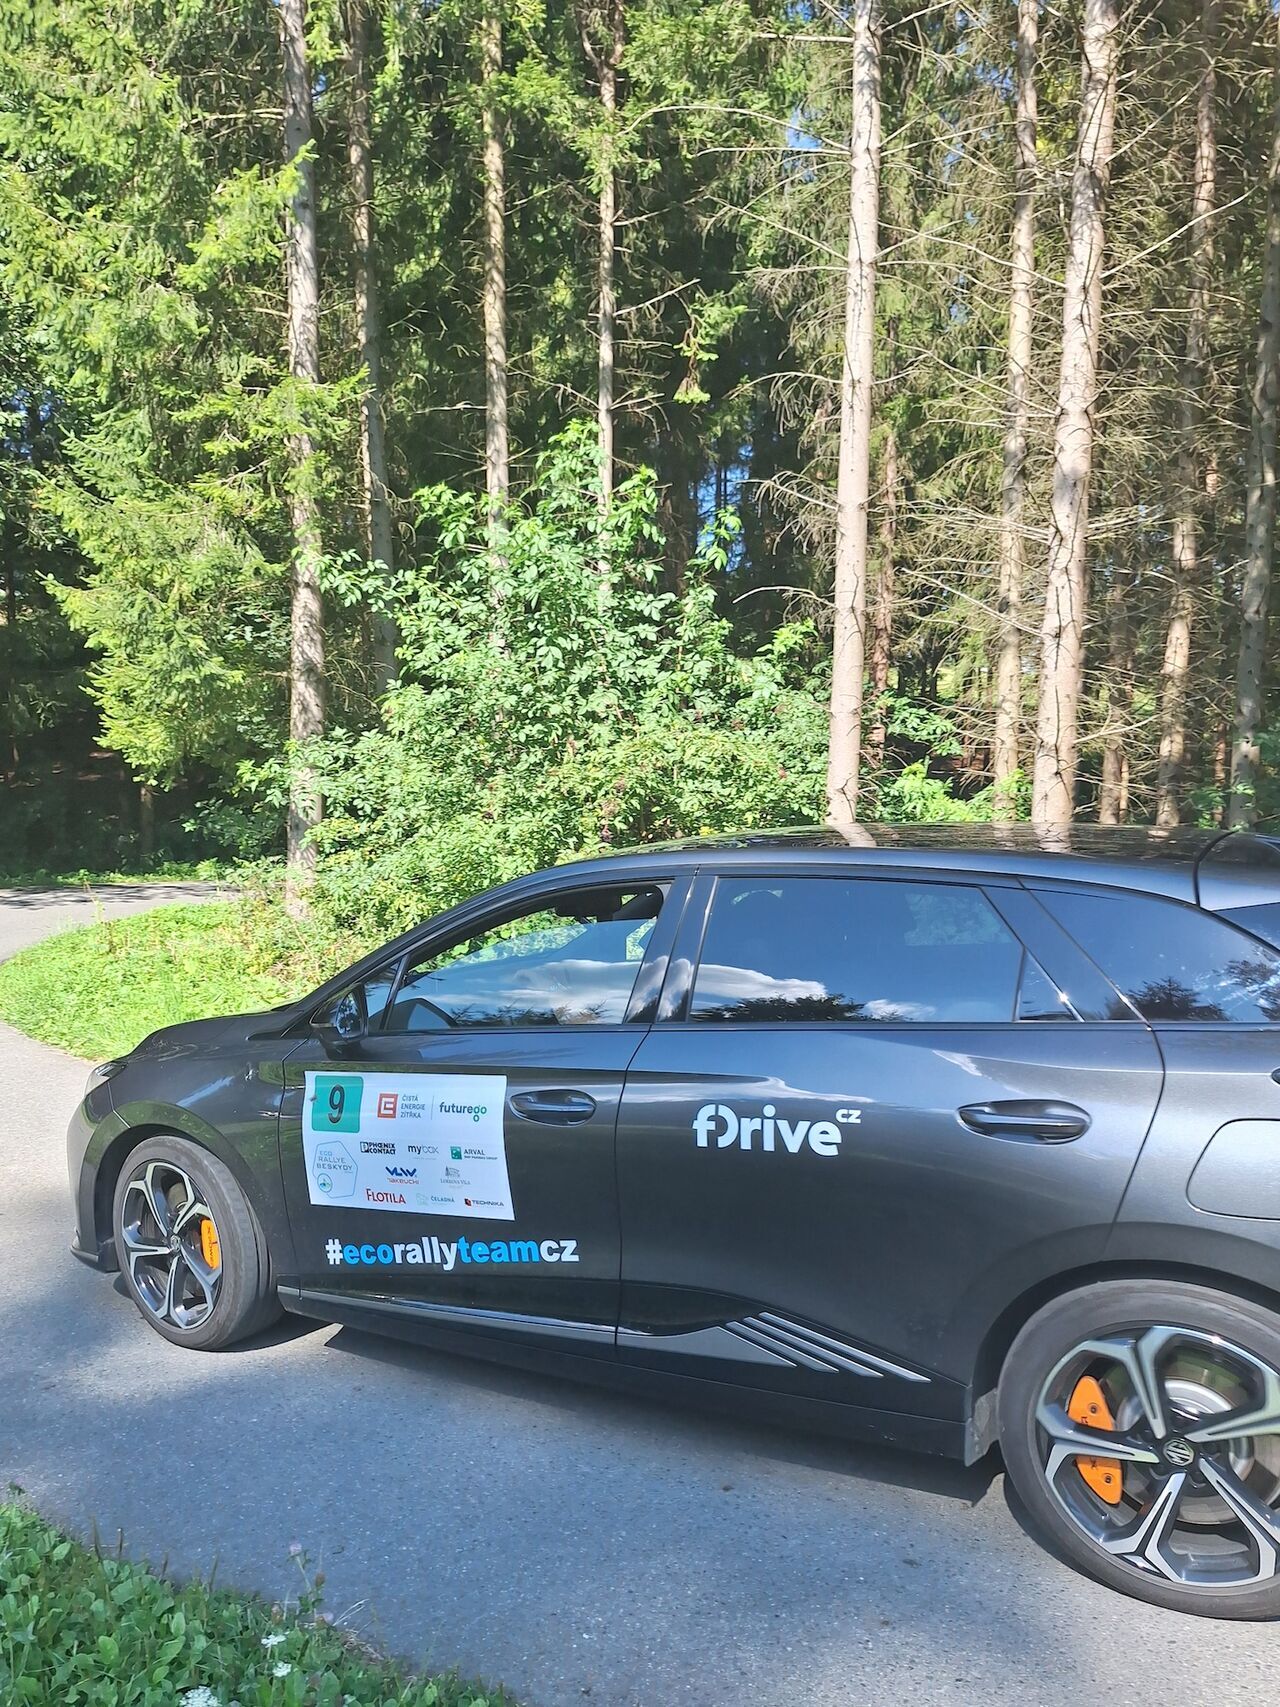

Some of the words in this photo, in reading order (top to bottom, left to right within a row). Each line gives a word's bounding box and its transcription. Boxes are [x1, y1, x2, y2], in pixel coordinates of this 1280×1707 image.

[328, 1084, 346, 1124] 9
[400, 1103, 426, 1111] ENERGIE
[318, 1156, 346, 1164] RALLYE
[316, 1163, 353, 1171] BESKYDY
[325, 1236, 580, 1271] #ecorallyteamcz
